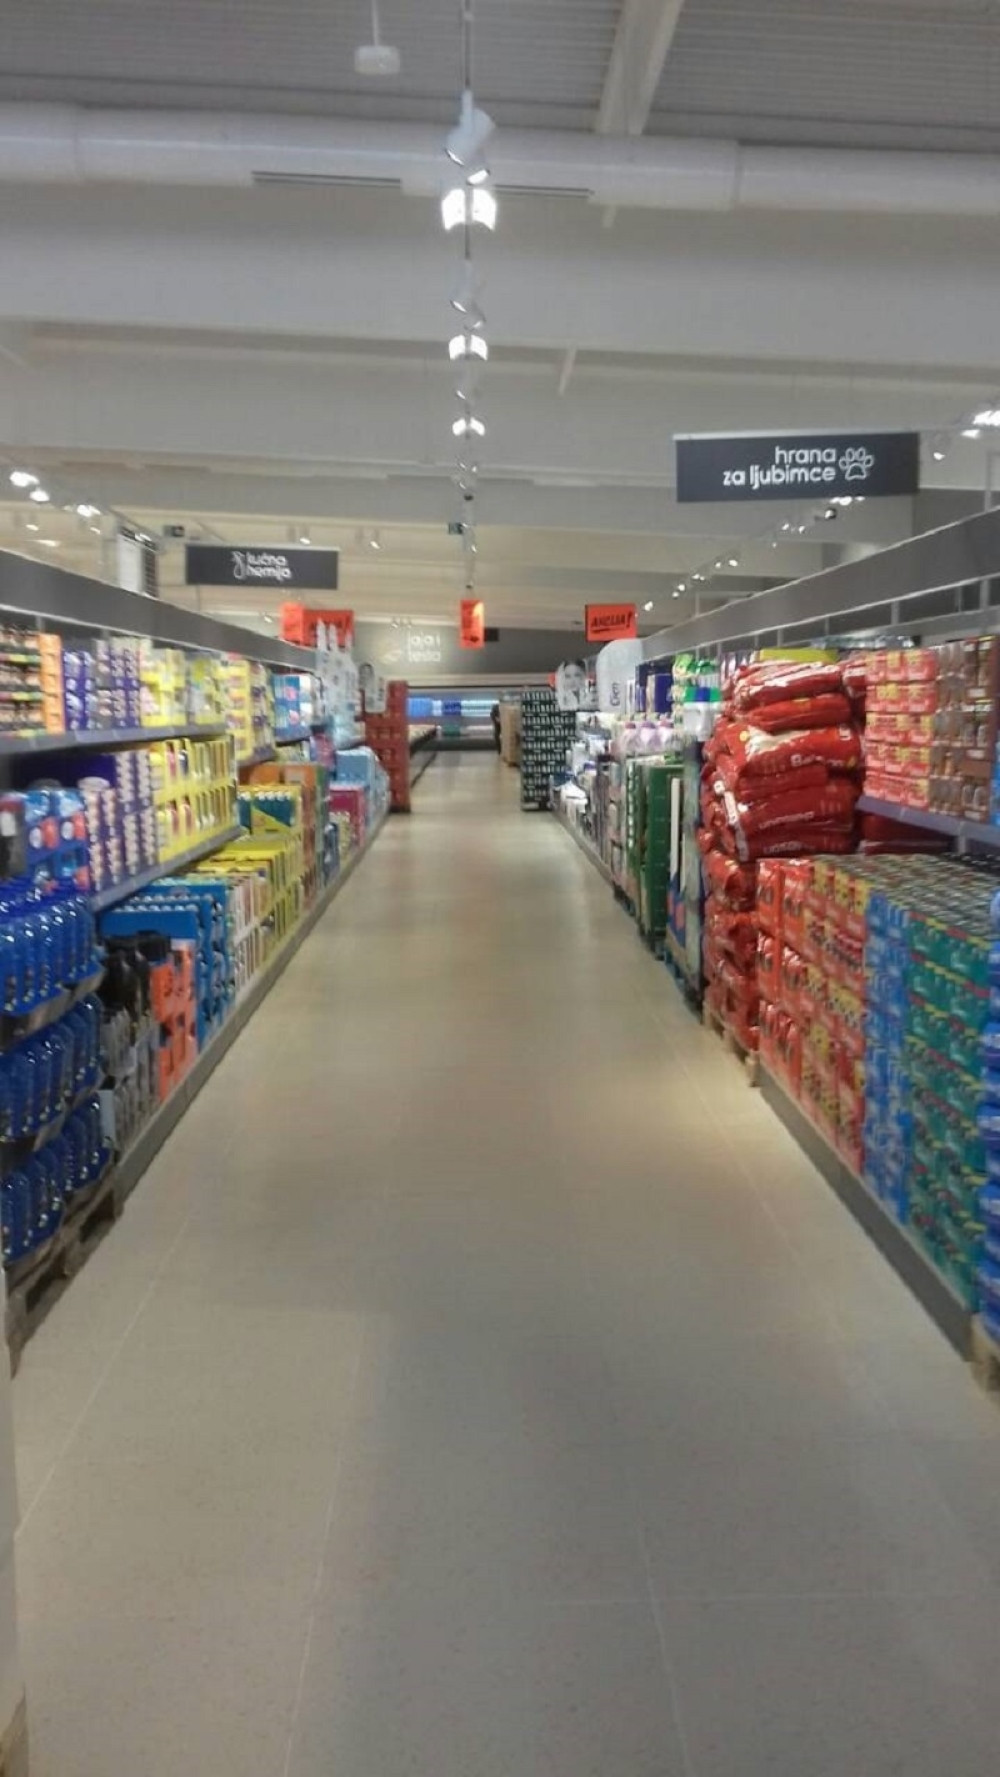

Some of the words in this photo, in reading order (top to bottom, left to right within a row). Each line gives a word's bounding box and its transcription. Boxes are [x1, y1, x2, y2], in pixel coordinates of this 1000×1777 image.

[775, 446, 836, 464] hrana
[723, 470, 746, 486] za
[750, 464, 836, 490] ljubimce
